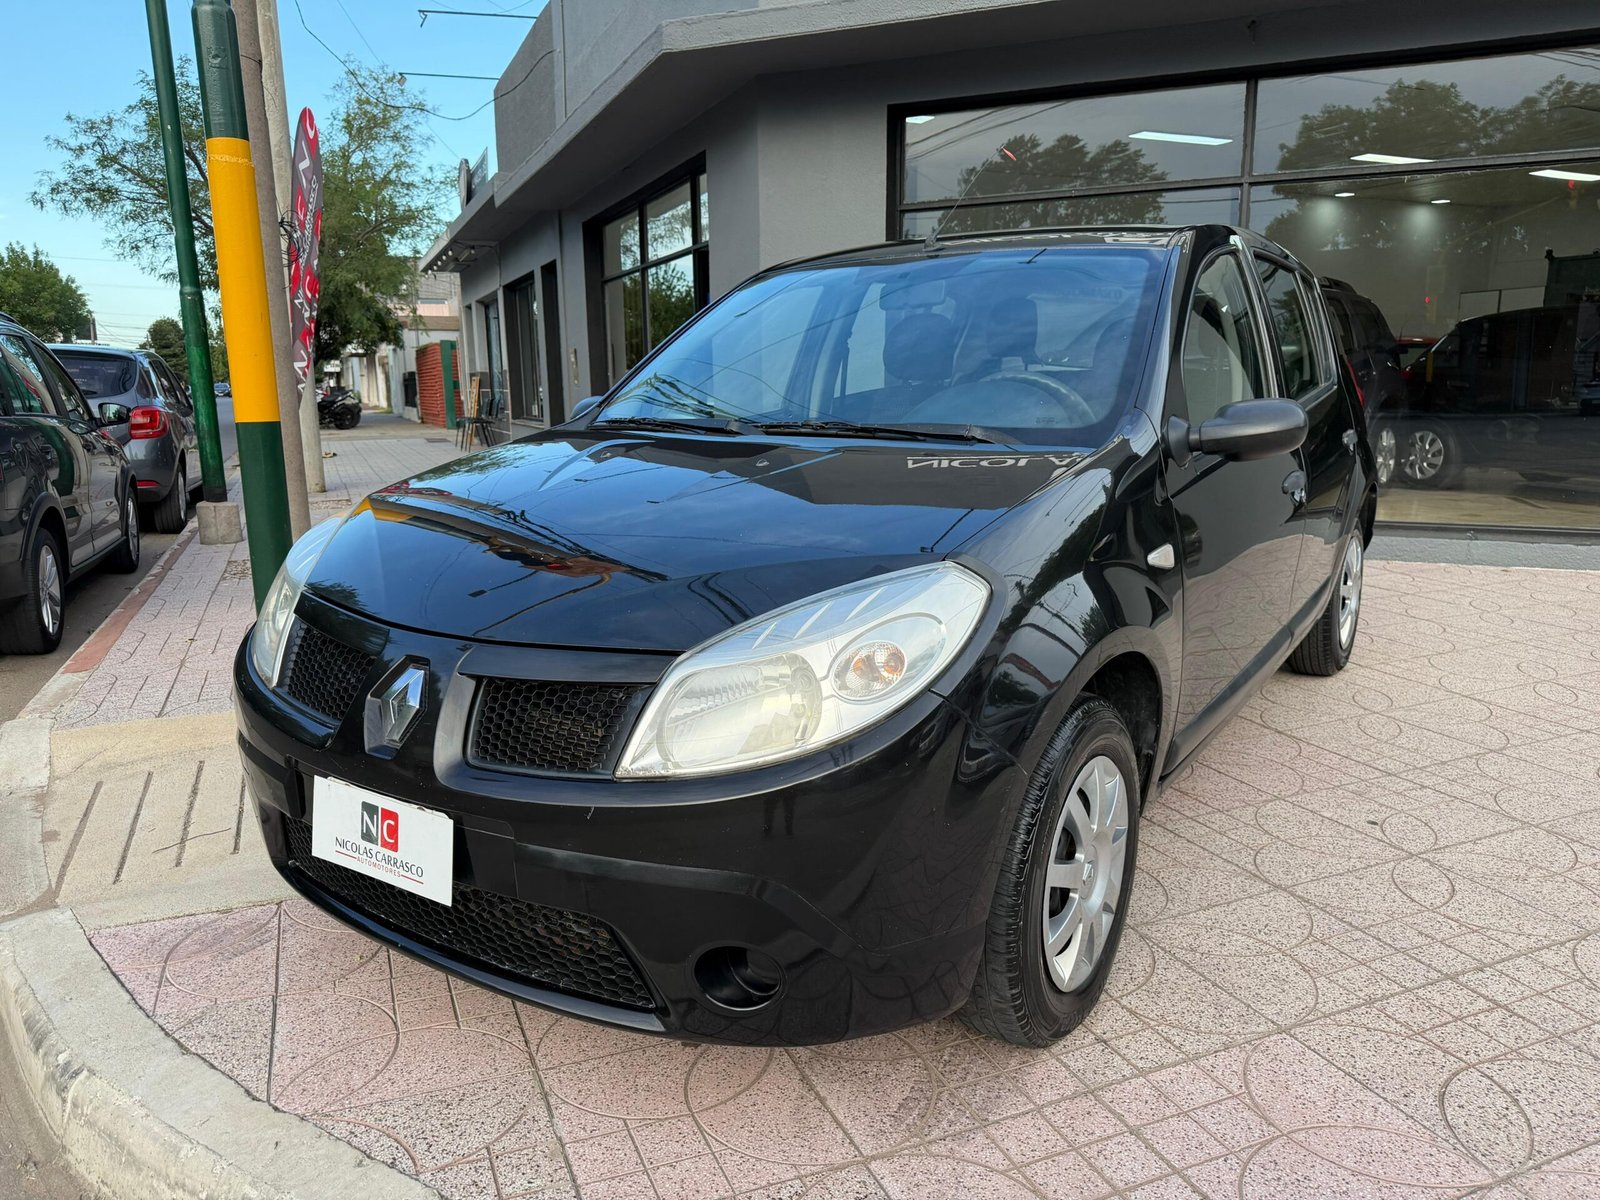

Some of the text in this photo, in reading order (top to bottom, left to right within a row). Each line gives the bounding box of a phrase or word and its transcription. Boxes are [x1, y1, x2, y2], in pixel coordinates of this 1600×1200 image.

[335, 836, 424, 878] NICOLAS CARRASCO
[356, 856, 401, 878] AUTOMOTORES
